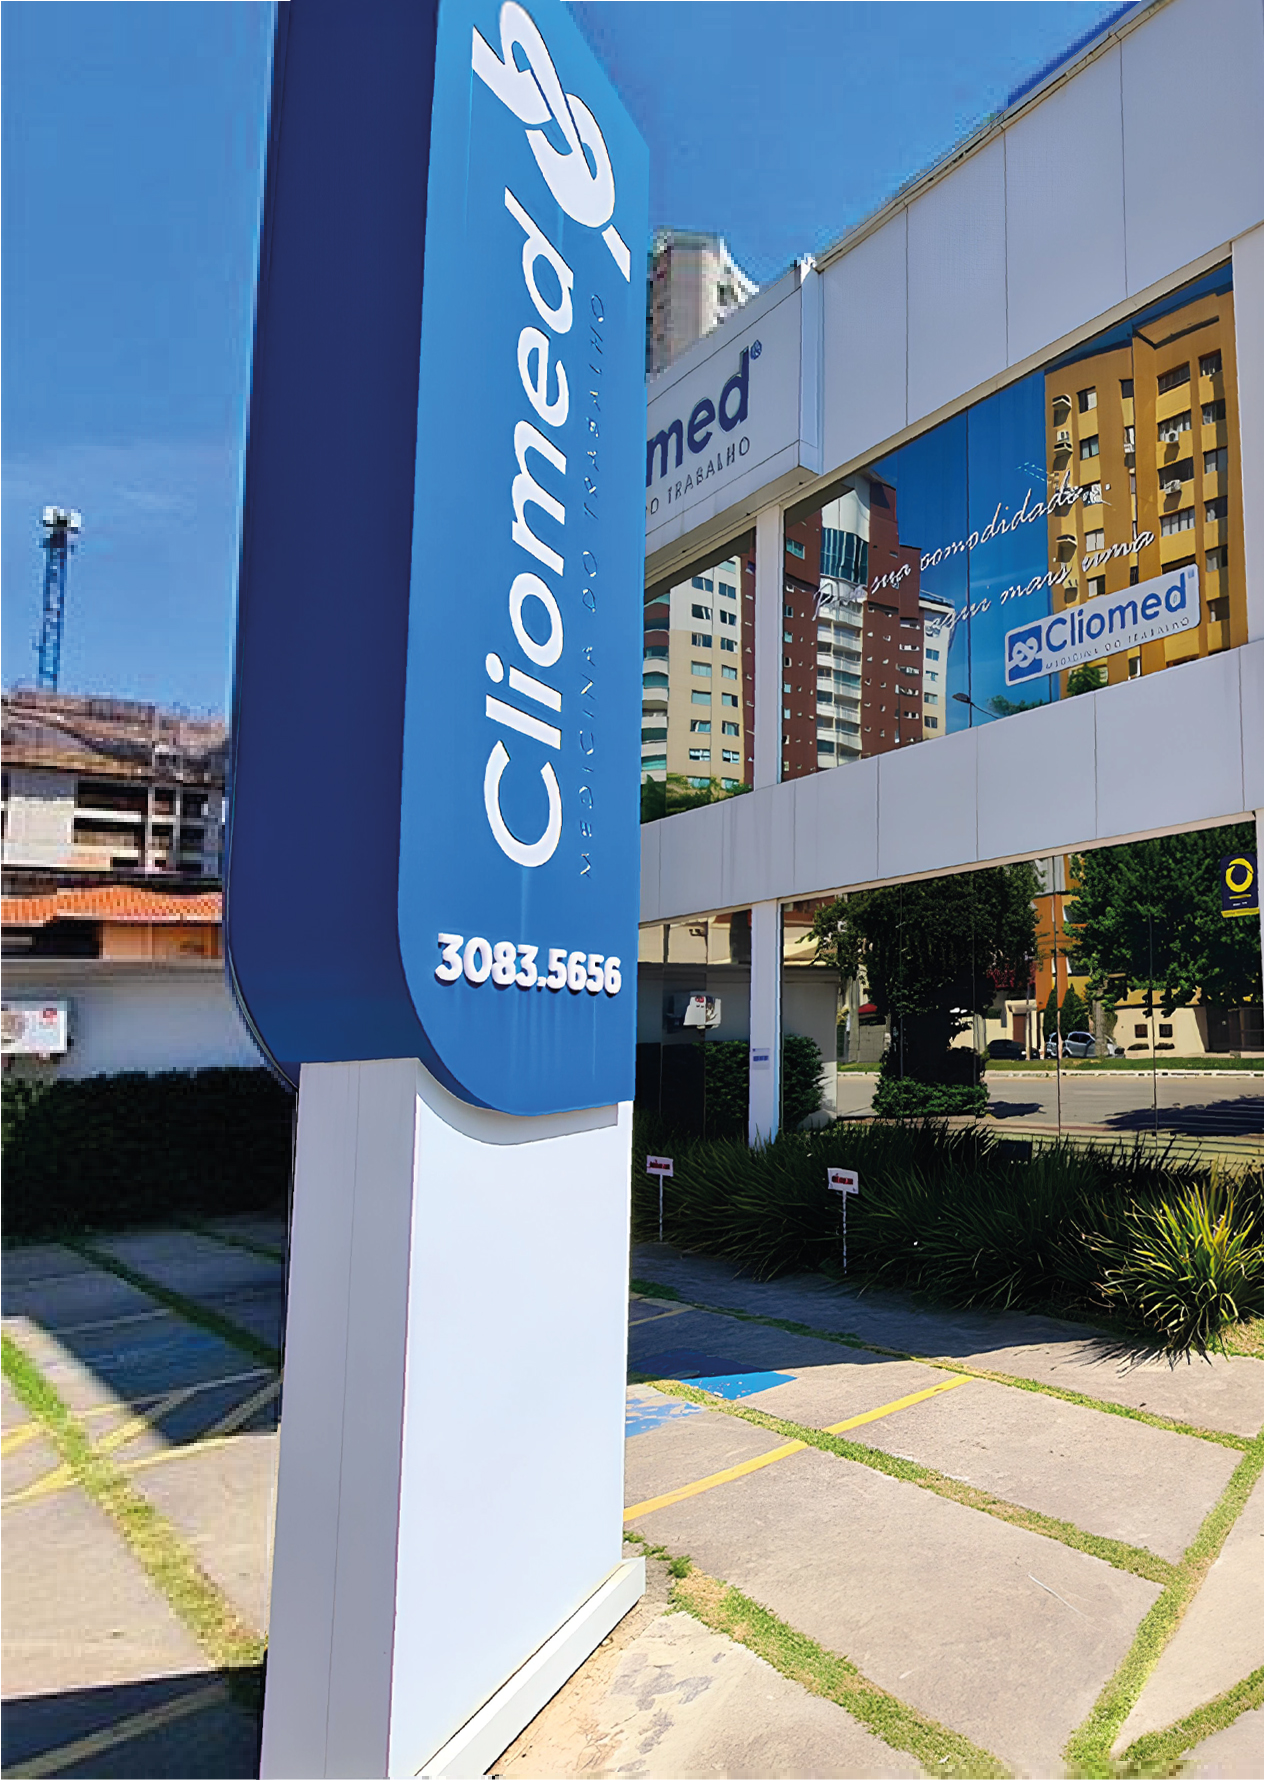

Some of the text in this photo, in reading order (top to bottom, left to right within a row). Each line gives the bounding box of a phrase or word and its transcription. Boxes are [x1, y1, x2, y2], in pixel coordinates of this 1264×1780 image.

[667, 436, 750, 504] TRABALHO
[485, 186, 574, 867] Cliomed
[1045, 571, 1187, 652] Cliomed
[435, 932, 622, 994] 3083.5656
